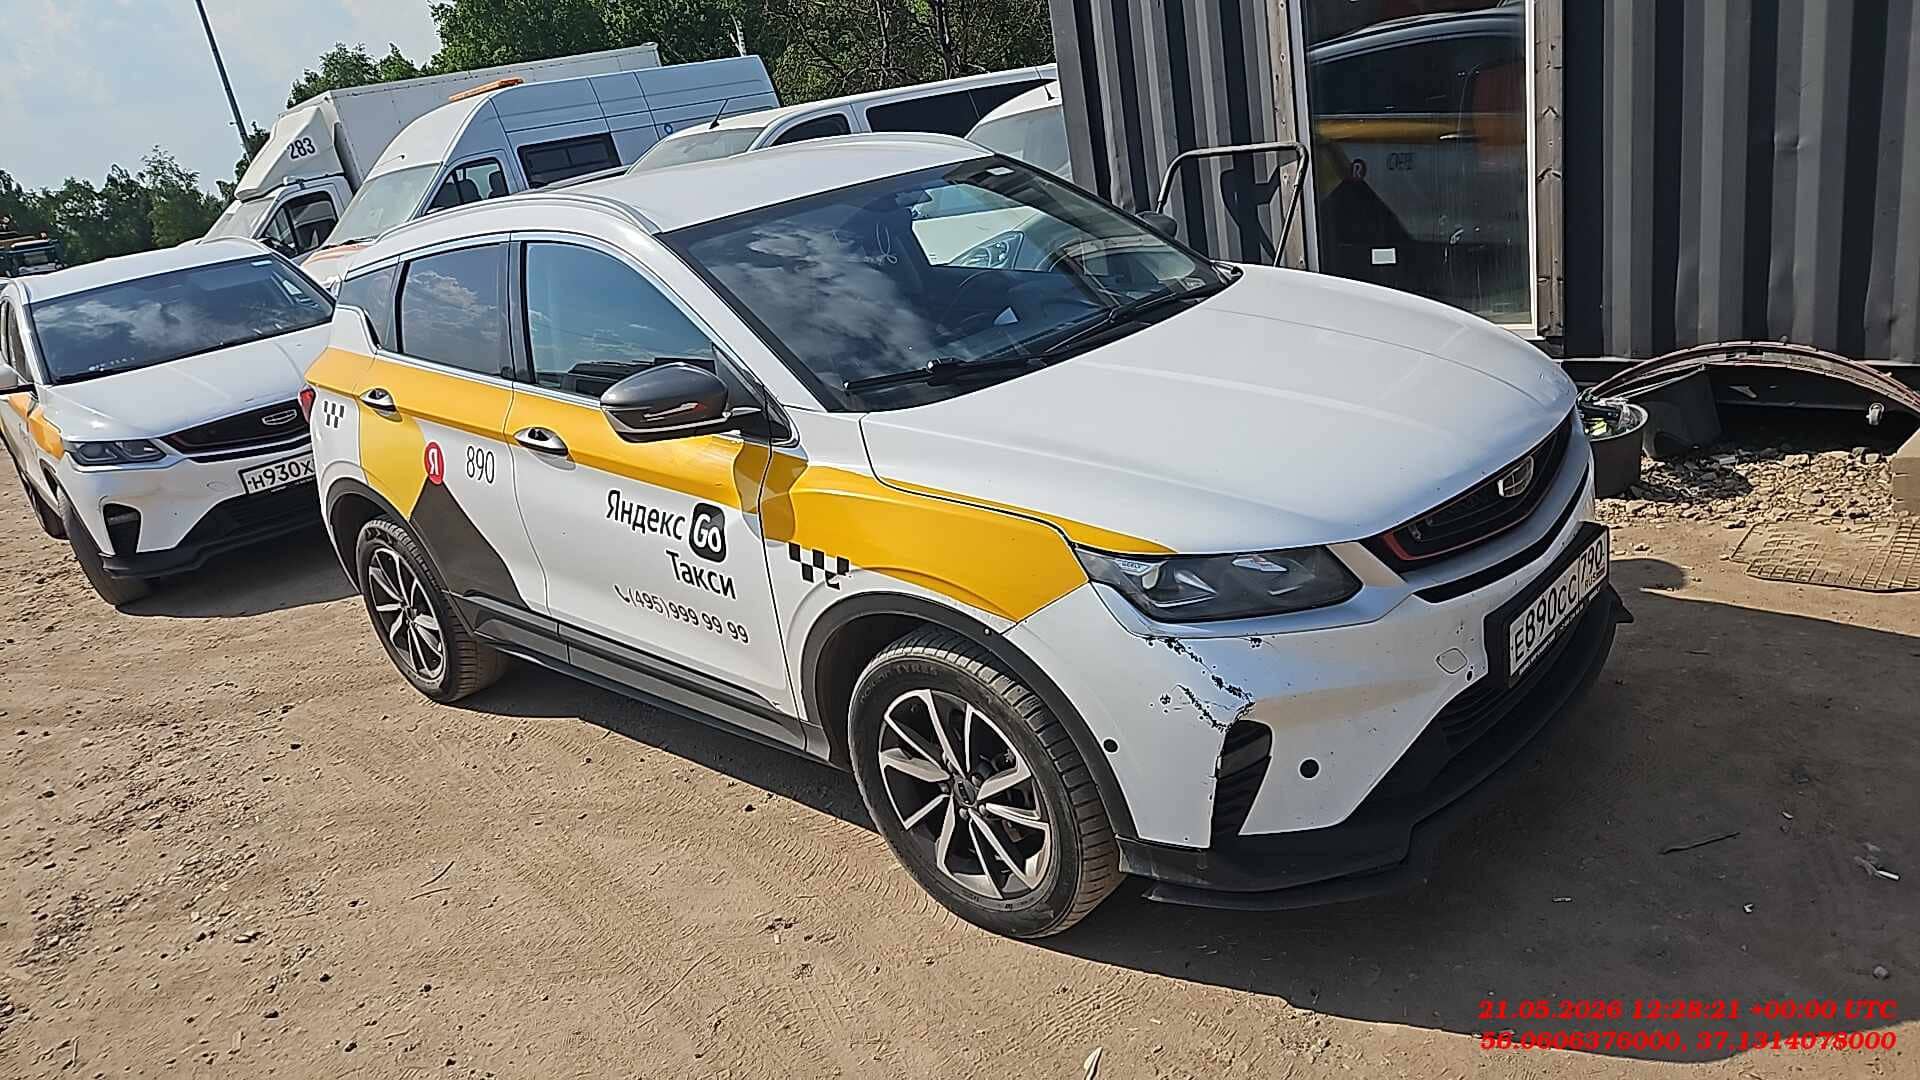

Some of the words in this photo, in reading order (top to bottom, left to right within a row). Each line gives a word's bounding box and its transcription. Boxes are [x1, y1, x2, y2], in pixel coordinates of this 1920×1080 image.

[287, 137, 316, 160] 283
[251, 459, 314, 490] Н930Х
[466, 445, 495, 484] 890
[606, 489, 686, 541] Яндекс
[692, 512, 723, 553] Go
[666, 549, 736, 600] Такси
[1580, 539, 1603, 584] 790
[628, 587, 699, 626] (495)999
[701, 612, 723, 634] 99
[727, 621, 749, 644] 99
